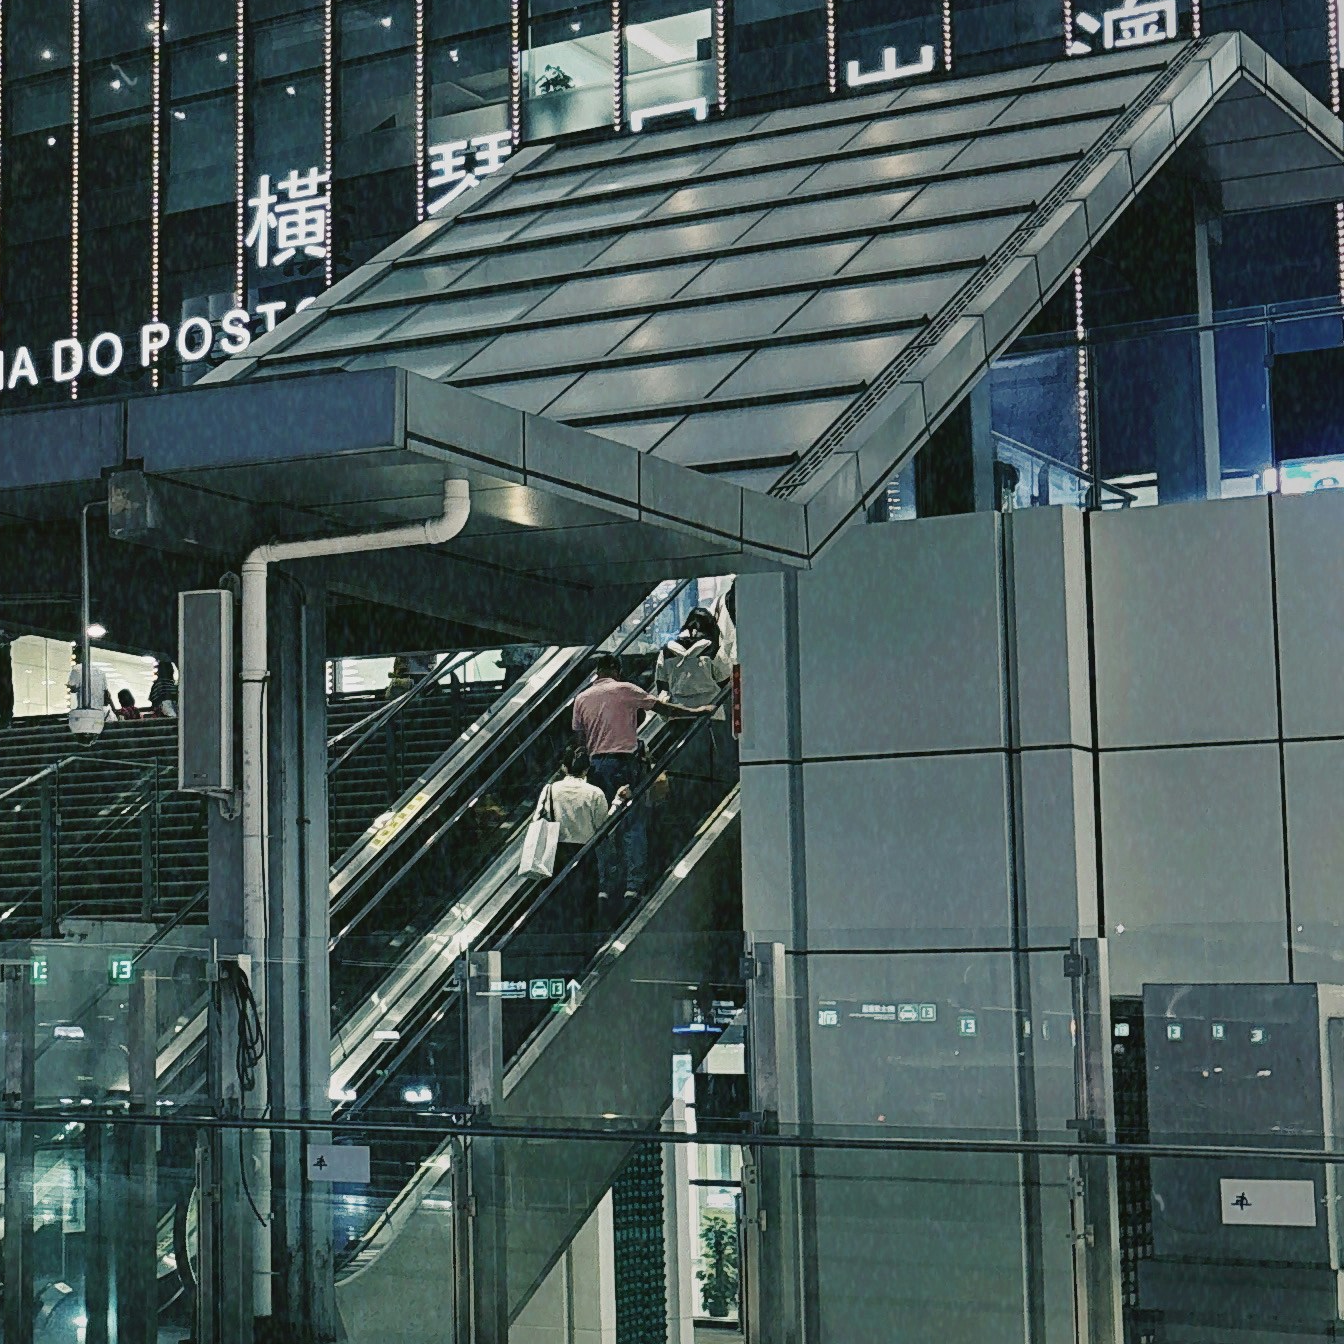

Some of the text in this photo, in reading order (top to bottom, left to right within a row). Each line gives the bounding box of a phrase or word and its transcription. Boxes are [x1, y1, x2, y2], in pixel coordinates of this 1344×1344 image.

[52, 331, 124, 384] DO
[140, 296, 316, 368] POST
[112, 960, 133, 979] 13
[960, 1019, 976, 1033] 13
